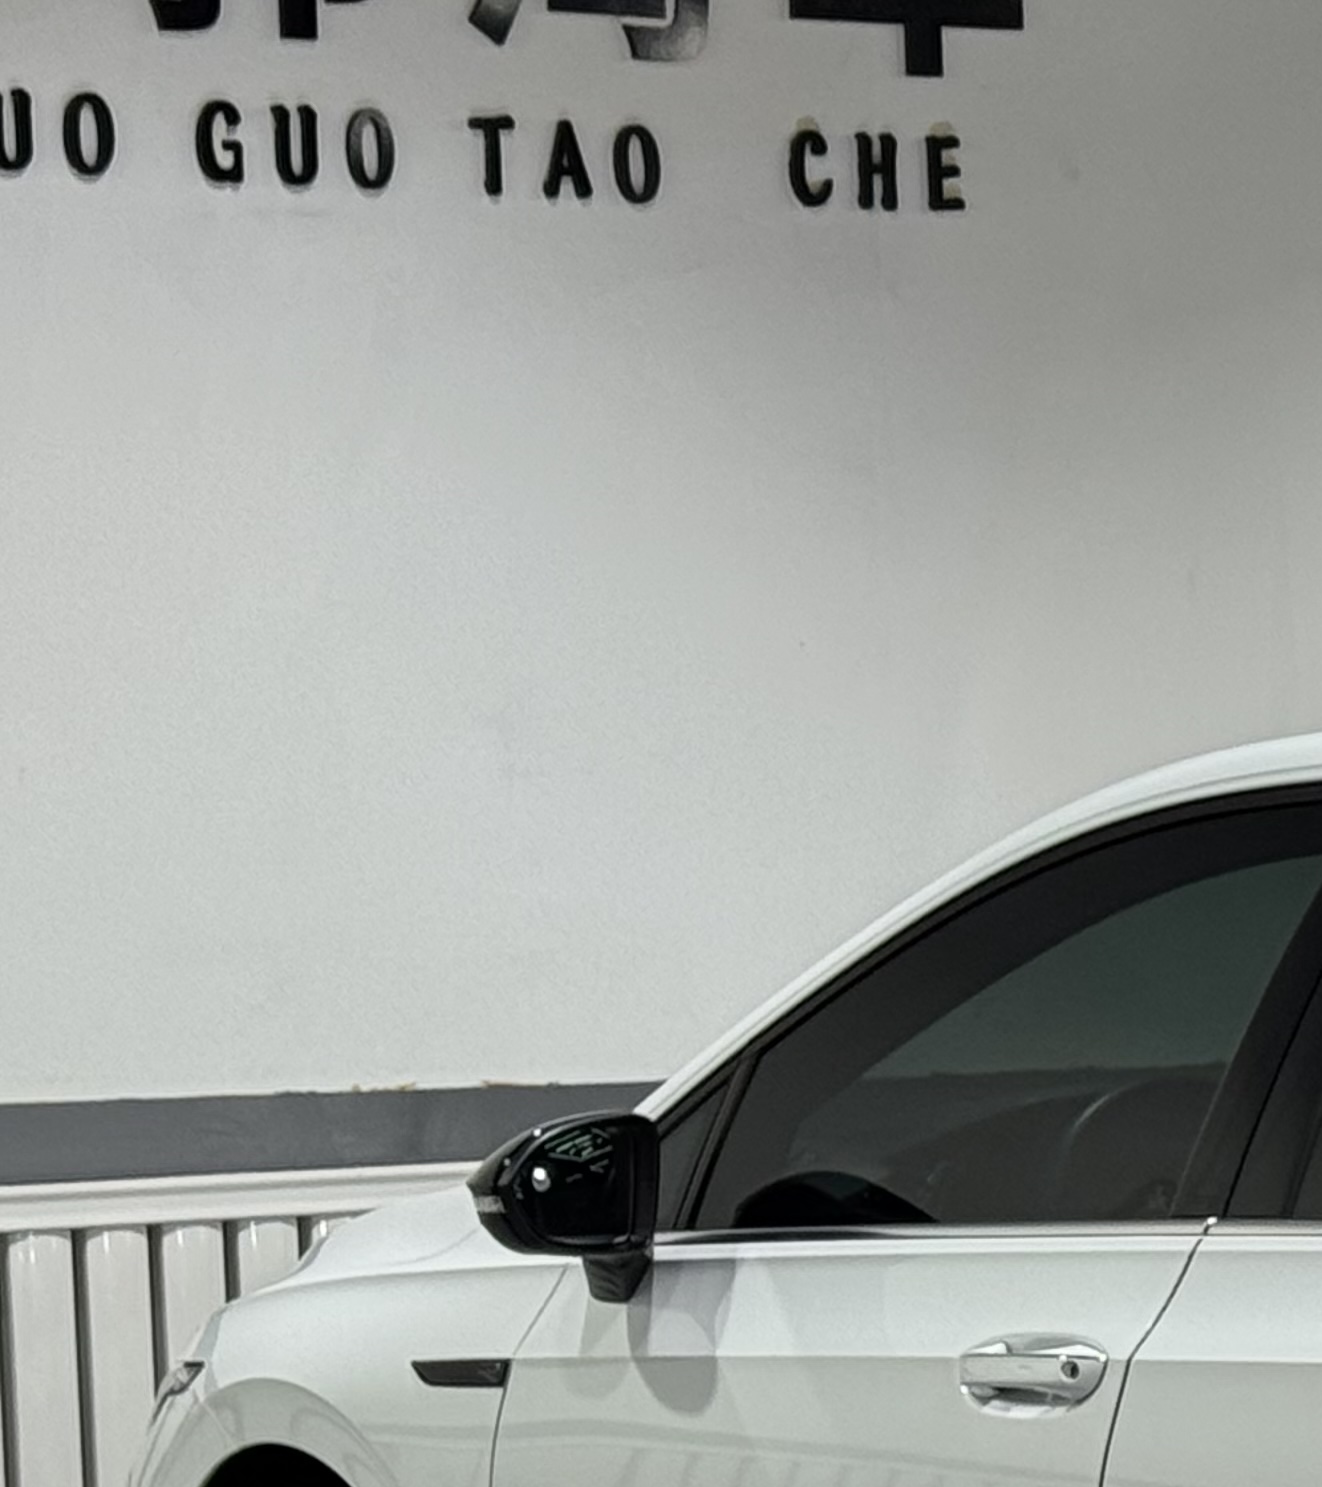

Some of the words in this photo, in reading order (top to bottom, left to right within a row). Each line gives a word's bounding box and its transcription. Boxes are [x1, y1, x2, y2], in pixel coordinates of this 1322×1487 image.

[195, 100, 395, 189] GUO
[467, 114, 661, 204] TAO
[788, 129, 966, 211] CHE
